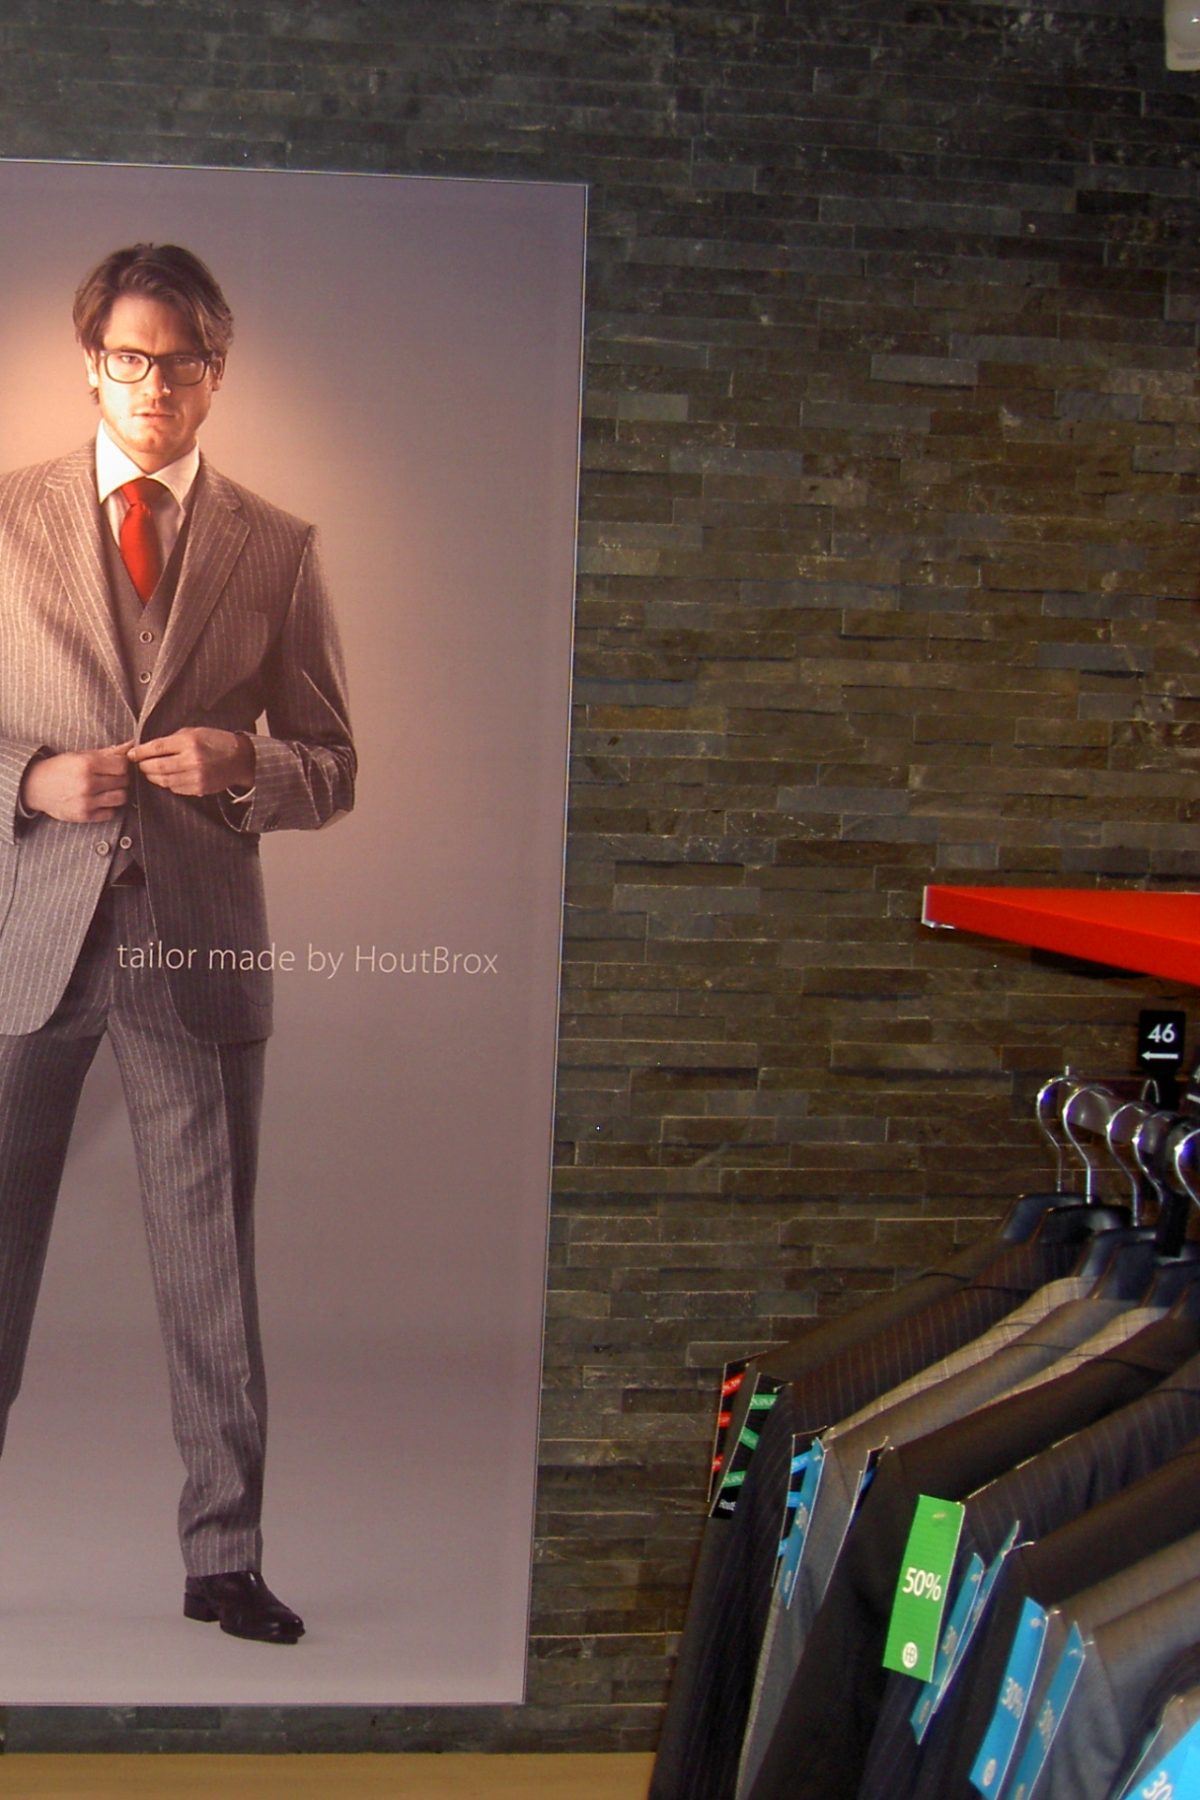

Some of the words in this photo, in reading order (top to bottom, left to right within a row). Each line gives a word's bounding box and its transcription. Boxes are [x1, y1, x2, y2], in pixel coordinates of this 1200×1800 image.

[117, 941, 198, 970] tailor
[208, 942, 296, 972] made
[307, 943, 344, 980] by
[355, 944, 499, 974] HoutBrox
[1147, 1022, 1176, 1043] 46
[902, 1566, 942, 1602] 50%
[1143, 1770, 1173, 1800] 30
